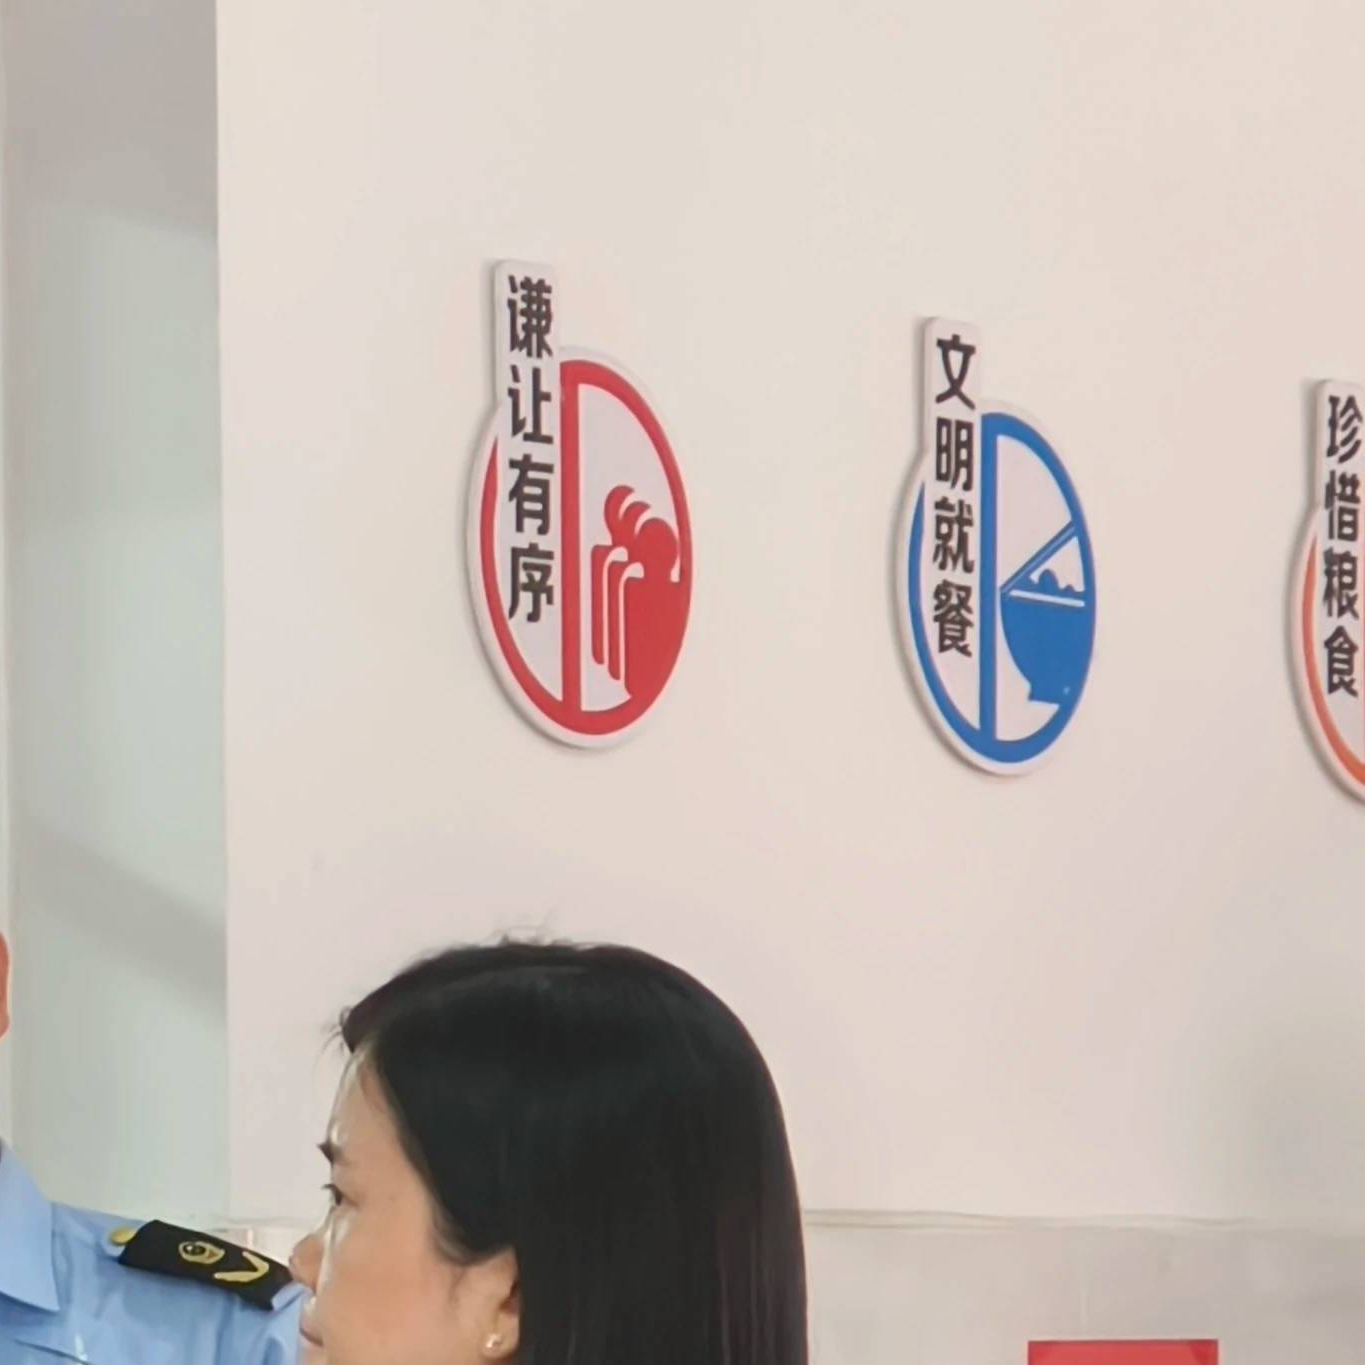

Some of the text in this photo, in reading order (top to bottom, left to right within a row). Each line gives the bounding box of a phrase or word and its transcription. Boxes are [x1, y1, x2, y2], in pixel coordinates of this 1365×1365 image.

[506, 274, 555, 622] 谦让有序
[933, 333, 975, 658] 文明就餐
[1322, 395, 1364, 698] 珍惜粮食
